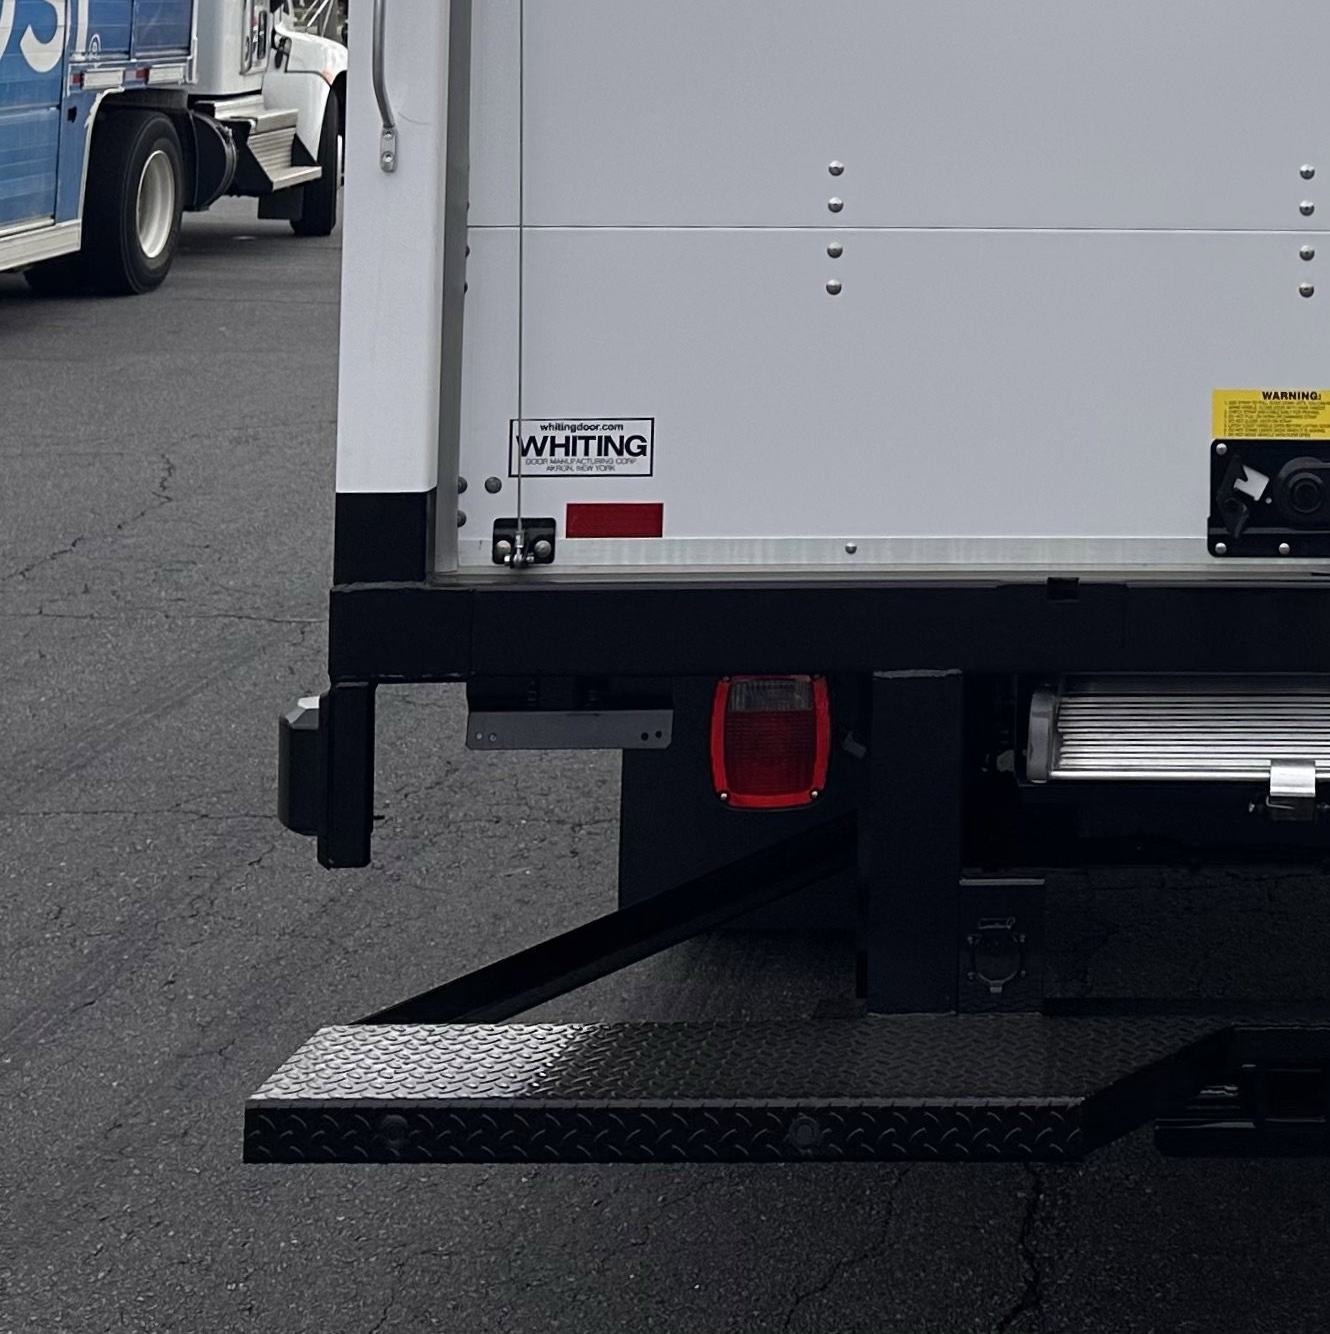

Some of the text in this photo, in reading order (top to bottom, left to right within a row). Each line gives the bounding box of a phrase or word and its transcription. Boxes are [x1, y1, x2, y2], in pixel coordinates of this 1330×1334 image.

[539, 422, 624, 433] whitingdoor.com
[515, 434, 648, 458] WHITING
[525, 457, 548, 465] DOOR
